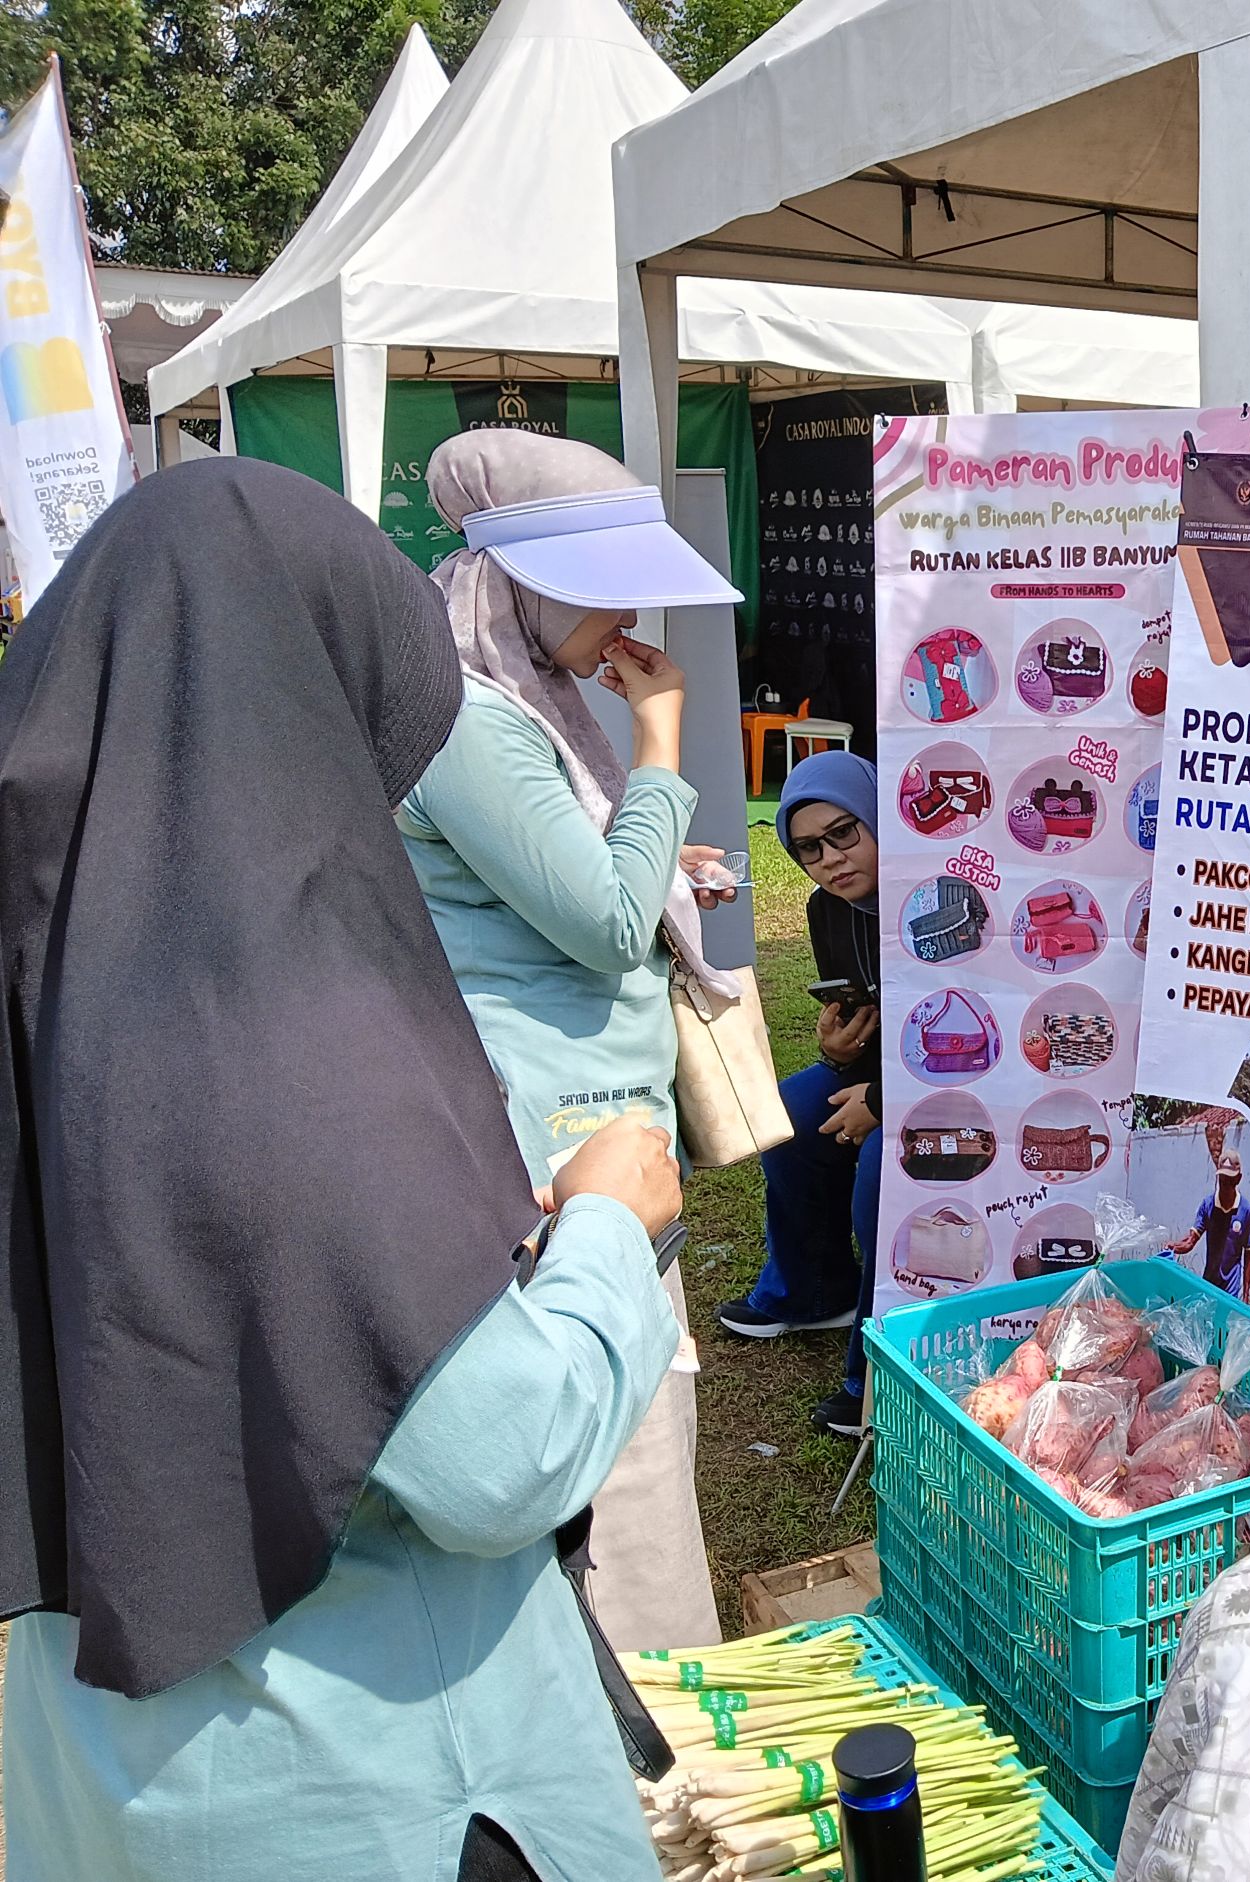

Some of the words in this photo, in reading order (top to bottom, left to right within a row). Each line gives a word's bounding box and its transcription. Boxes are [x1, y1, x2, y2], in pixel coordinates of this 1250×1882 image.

[811, 418, 842, 440] ROYAL
[928, 448, 1071, 486] Pameran
[1083, 442, 1181, 483] Produ
[900, 510, 970, 539] warga
[977, 505, 1045, 528] Binaan
[1052, 499, 1181, 535] Pemasyaraka
[1184, 530, 1209, 540] RUMAH
[1210, 531, 1242, 542] TAHANAN
[910, 549, 980, 572] RUTAN
[987, 546, 1052, 570] KELAS
[1093, 545, 1177, 567] BANYUM
[1000, 585, 1026, 596] FROM
[1028, 585, 1059, 596] HANDS
[1062, 586, 1074, 596] TO
[1076, 585, 1113, 597] HEARTS
[1079, 736, 1107, 761] Unik
[946, 859, 1001, 890] CUSTOM
[1188, 900, 1247, 932] JAHE
[592, 1090, 609, 1103] BIN
[985, 1197, 1015, 1218] pouch
[1016, 1184, 1048, 1209] rajut
[894, 1269, 918, 1286] hand
[919, 1278, 938, 1297] bag
[990, 1316, 1022, 1335] karya
